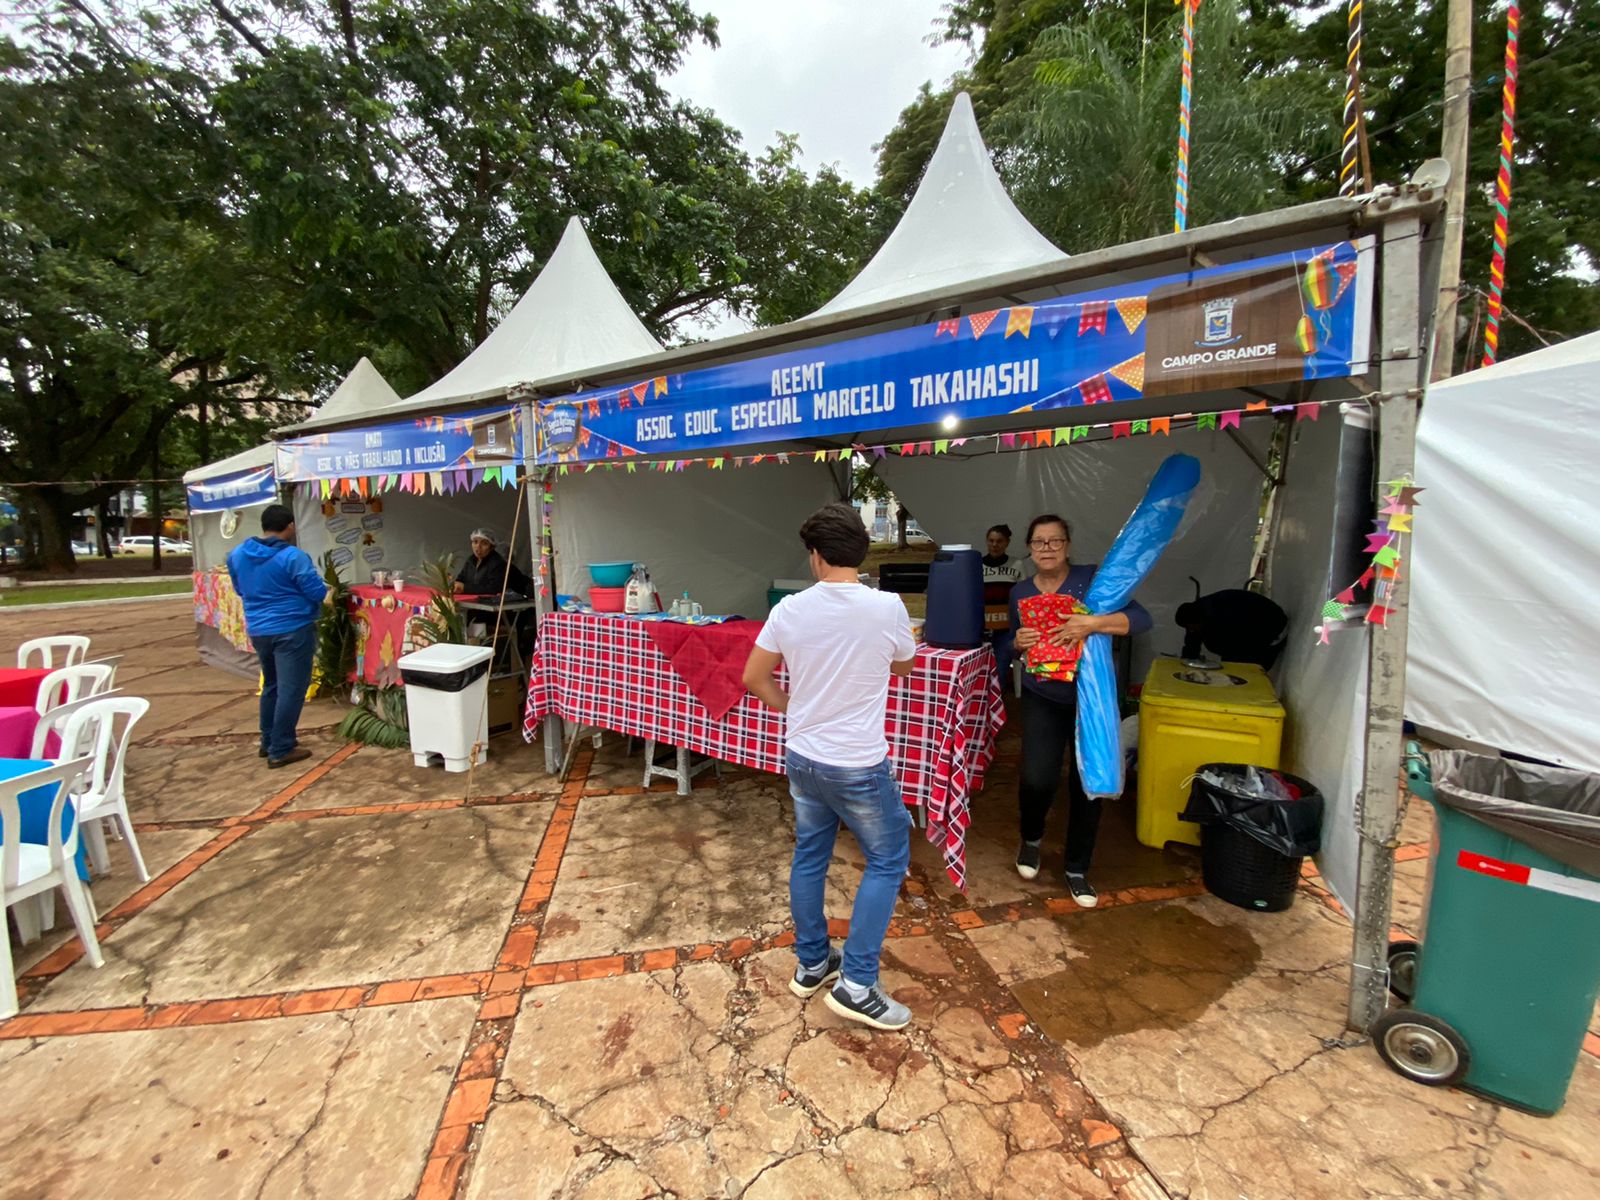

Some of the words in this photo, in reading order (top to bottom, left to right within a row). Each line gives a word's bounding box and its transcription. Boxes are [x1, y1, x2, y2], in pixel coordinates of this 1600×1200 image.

[1162, 352, 1213, 368] CAMPO
[1215, 343, 1276, 361] GRANDE
[771, 361, 826, 397] AEEMT
[636, 415, 677, 442] ASSOC.
[684, 408, 722, 437] EDUC.
[731, 396, 802, 431] ESPECIAL
[813, 381, 896, 421] MARCELO
[909, 358, 1040, 408] TAKAHASHI
[345, 450, 360, 469] MÃES
[362, 448, 402, 469] TRABALHANDO
[405, 447, 412, 465] A
[414, 440, 446, 464] INCLUSÃO
